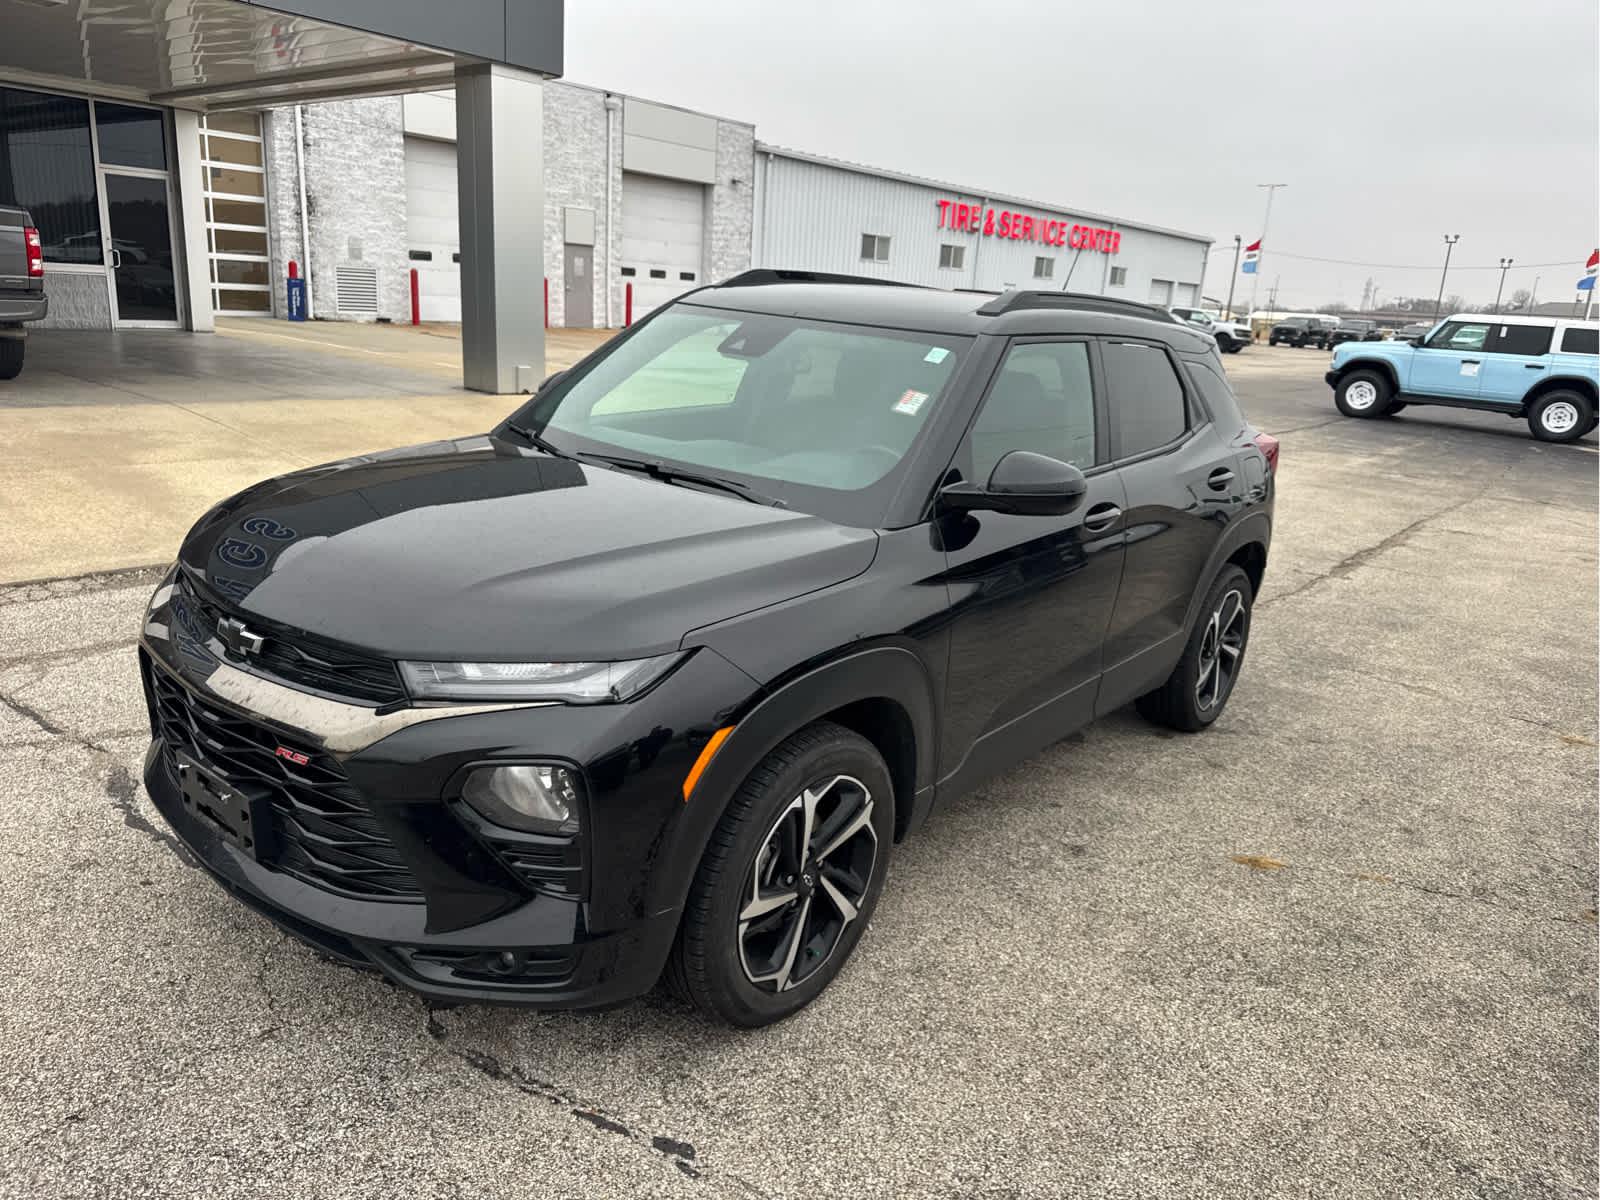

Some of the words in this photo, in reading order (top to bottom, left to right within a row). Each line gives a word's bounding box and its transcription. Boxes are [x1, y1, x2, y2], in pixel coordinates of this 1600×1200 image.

[938, 200, 981, 232] TIRE
[984, 209, 996, 236] &
[998, 210, 1067, 246] SERVICE
[1070, 224, 1122, 254] CENTER
[275, 747, 310, 766] RS
